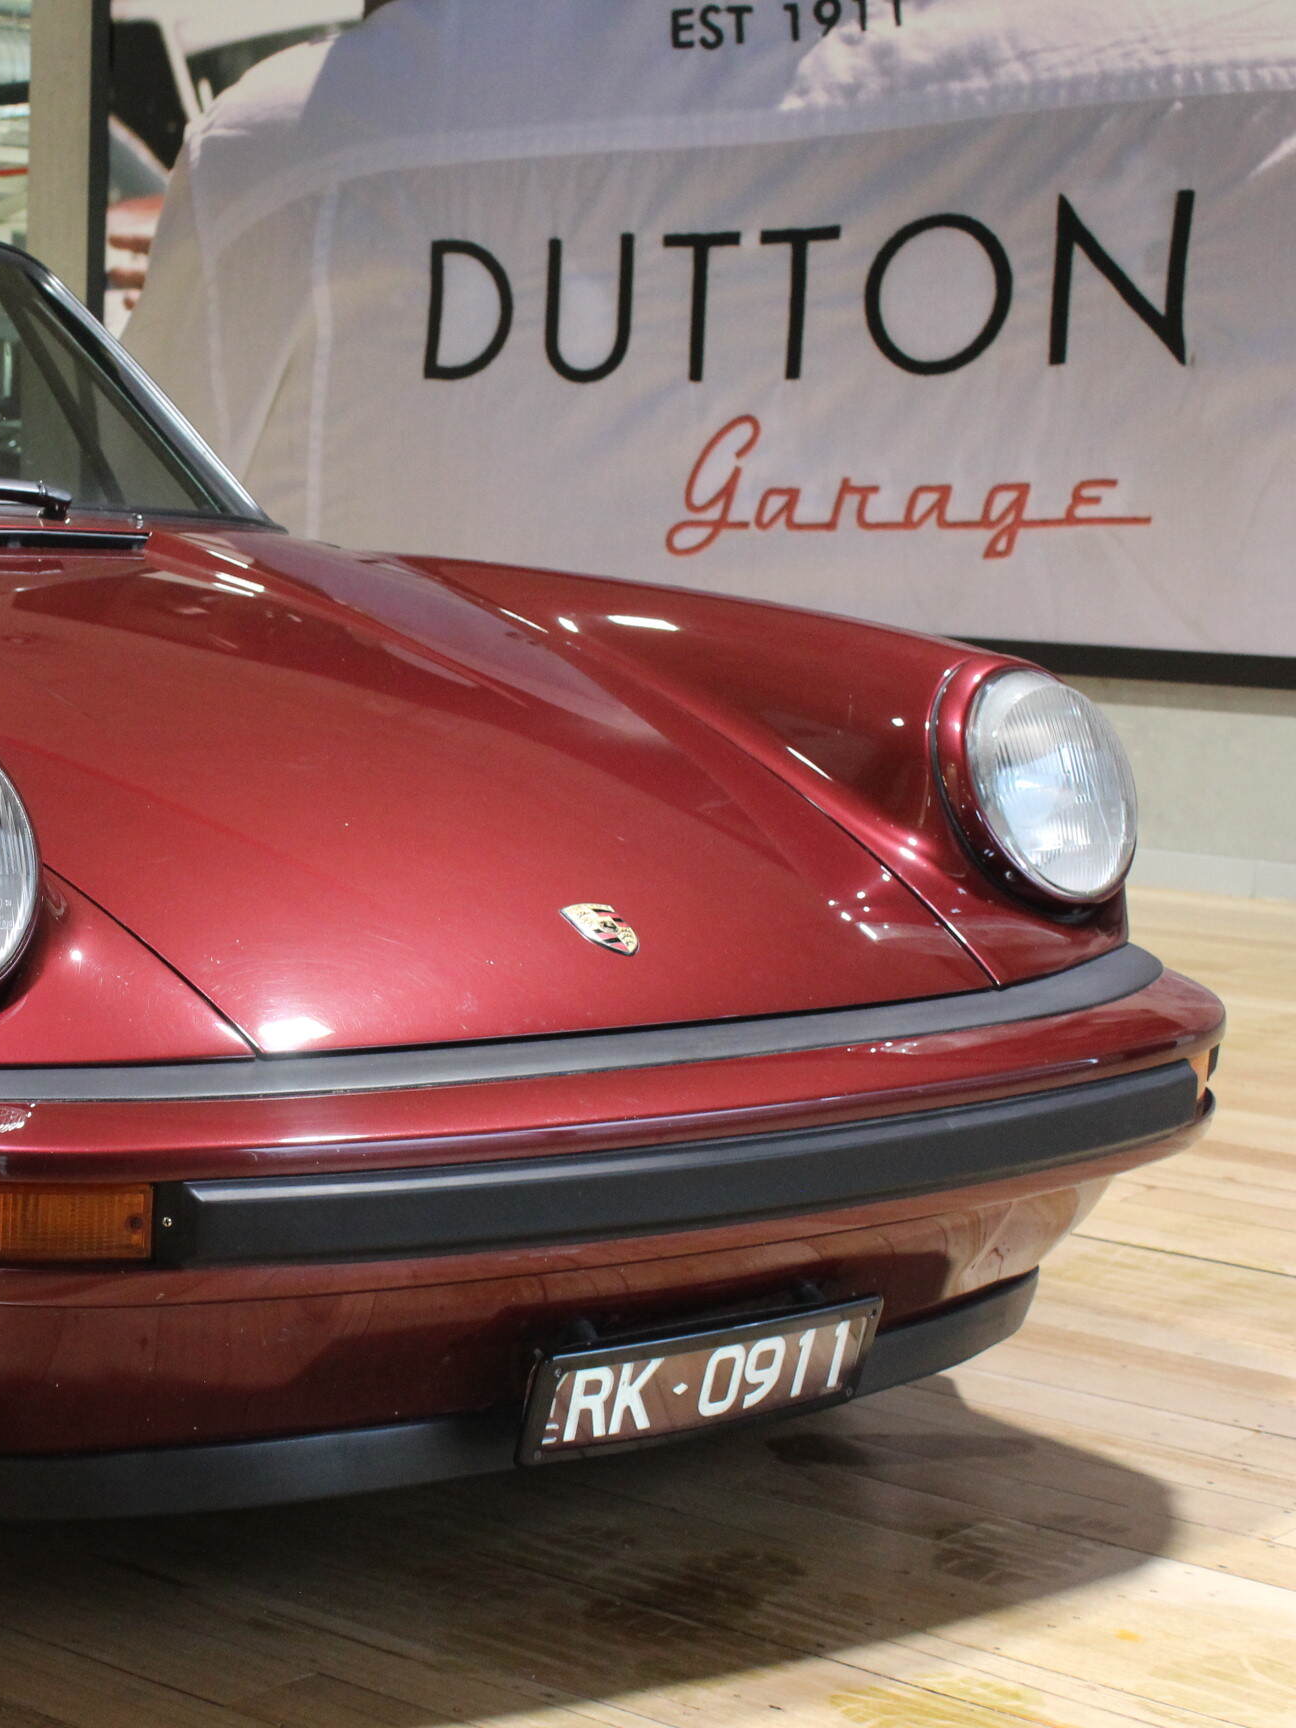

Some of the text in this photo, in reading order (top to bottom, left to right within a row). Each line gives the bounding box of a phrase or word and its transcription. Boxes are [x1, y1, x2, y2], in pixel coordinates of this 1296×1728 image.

[671, 0, 902, 49] EST 1911
[423, 189, 1195, 383] DUTTON
[666, 414, 1151, 559] Garage
